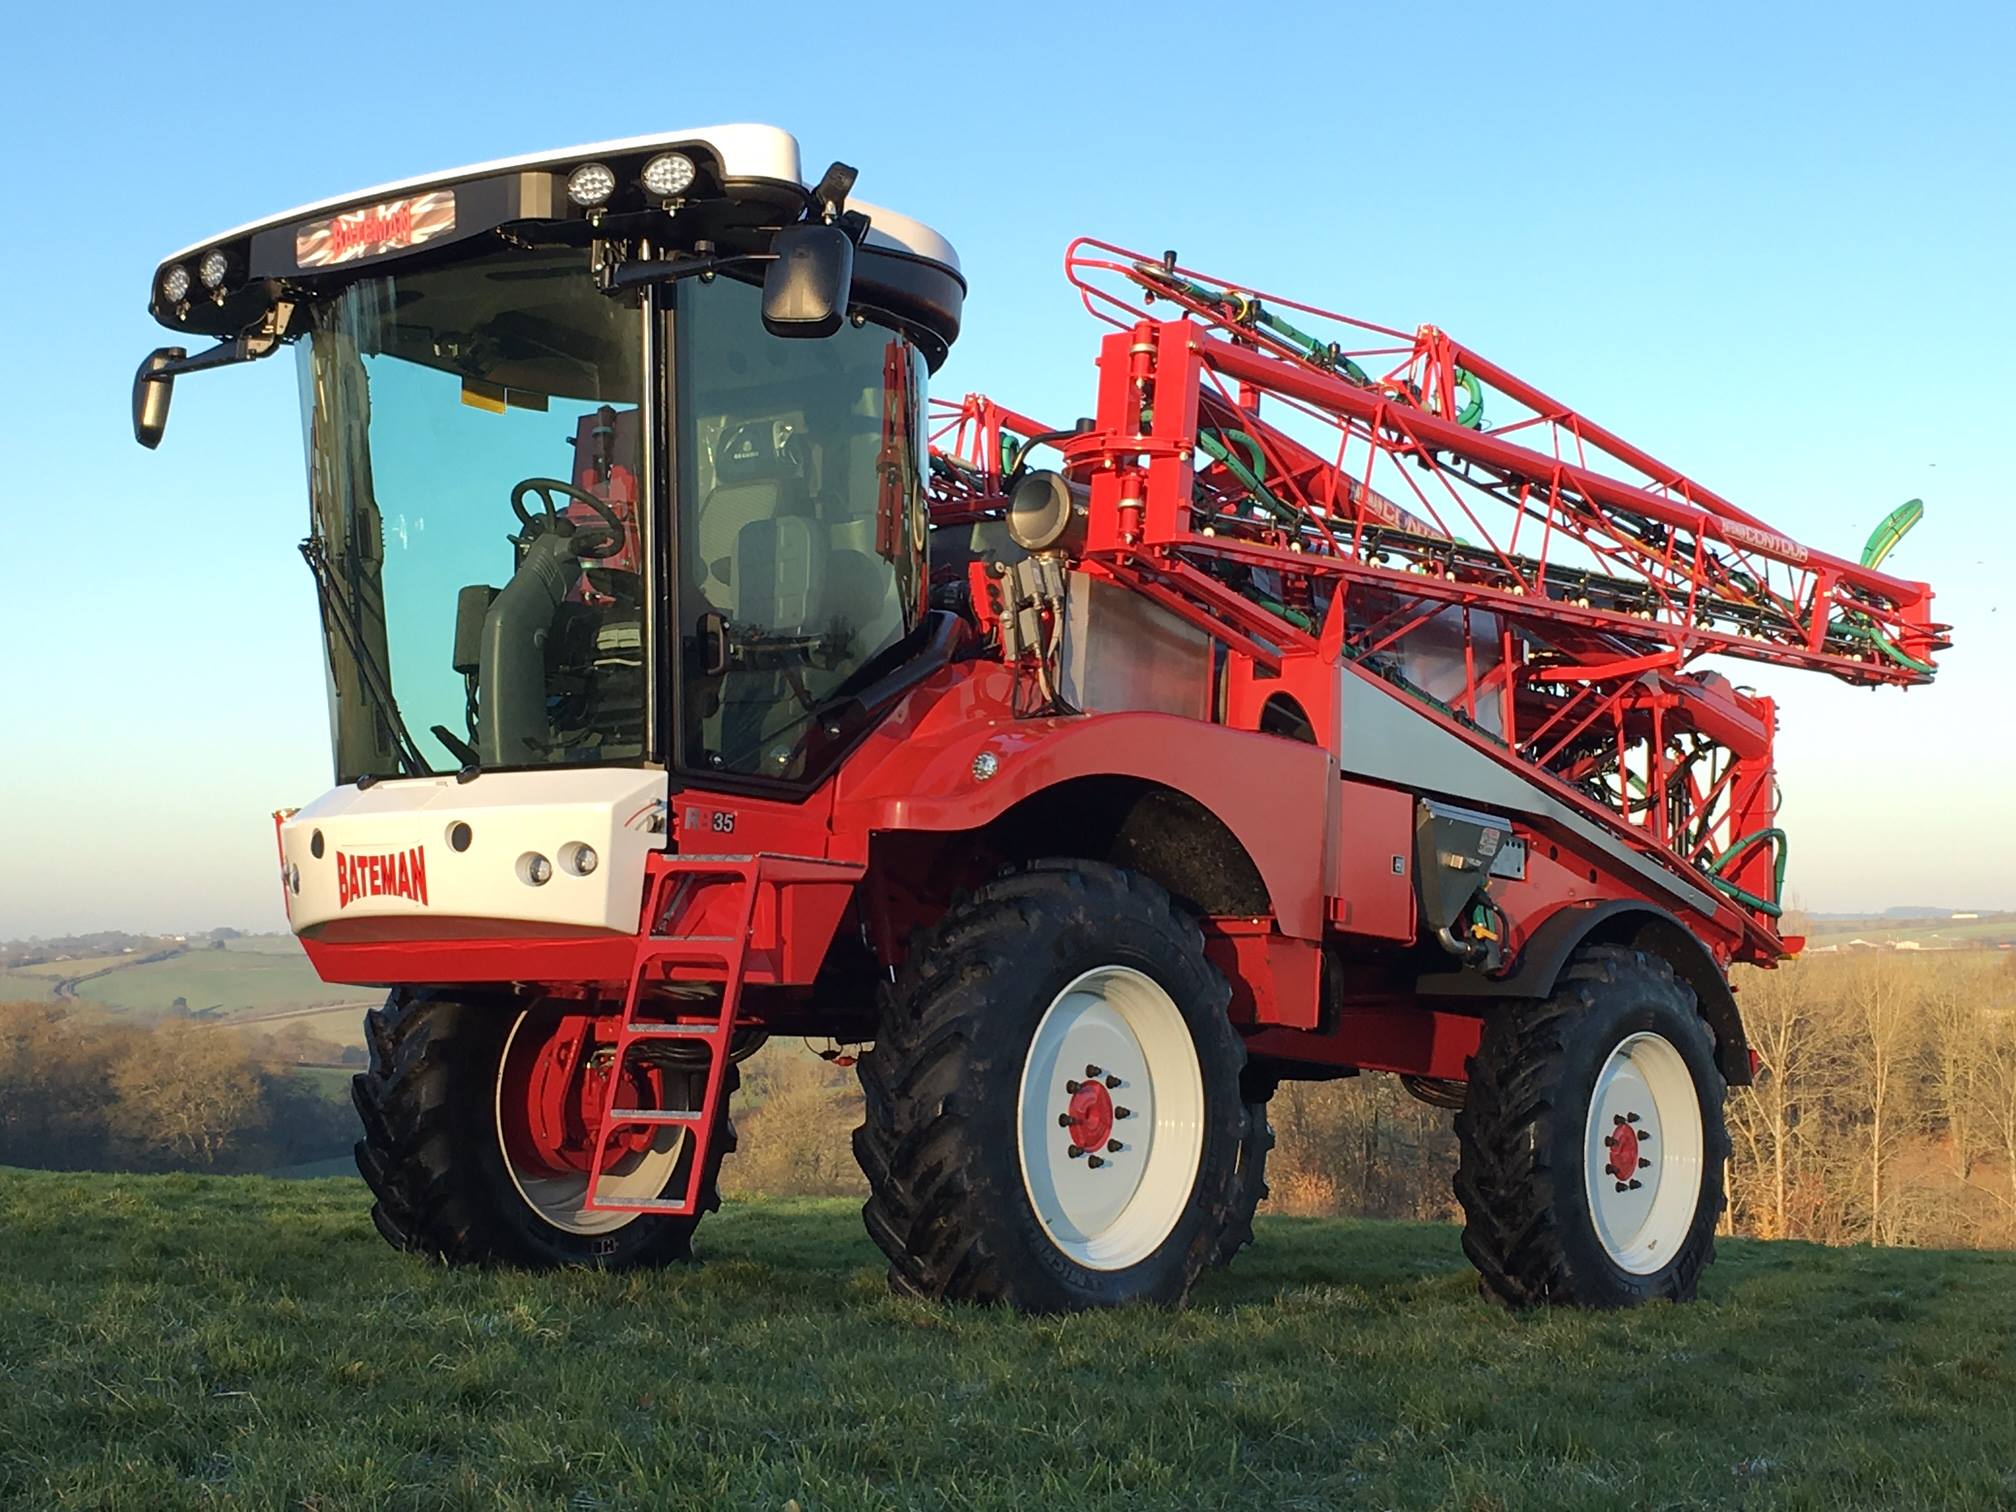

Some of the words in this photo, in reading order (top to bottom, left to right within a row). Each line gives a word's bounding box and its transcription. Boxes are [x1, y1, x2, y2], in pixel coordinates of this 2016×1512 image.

[332, 202, 411, 259] BATEMAN
[1744, 527, 1808, 562] CONTOUR
[336, 845, 428, 909] BATEMAN
